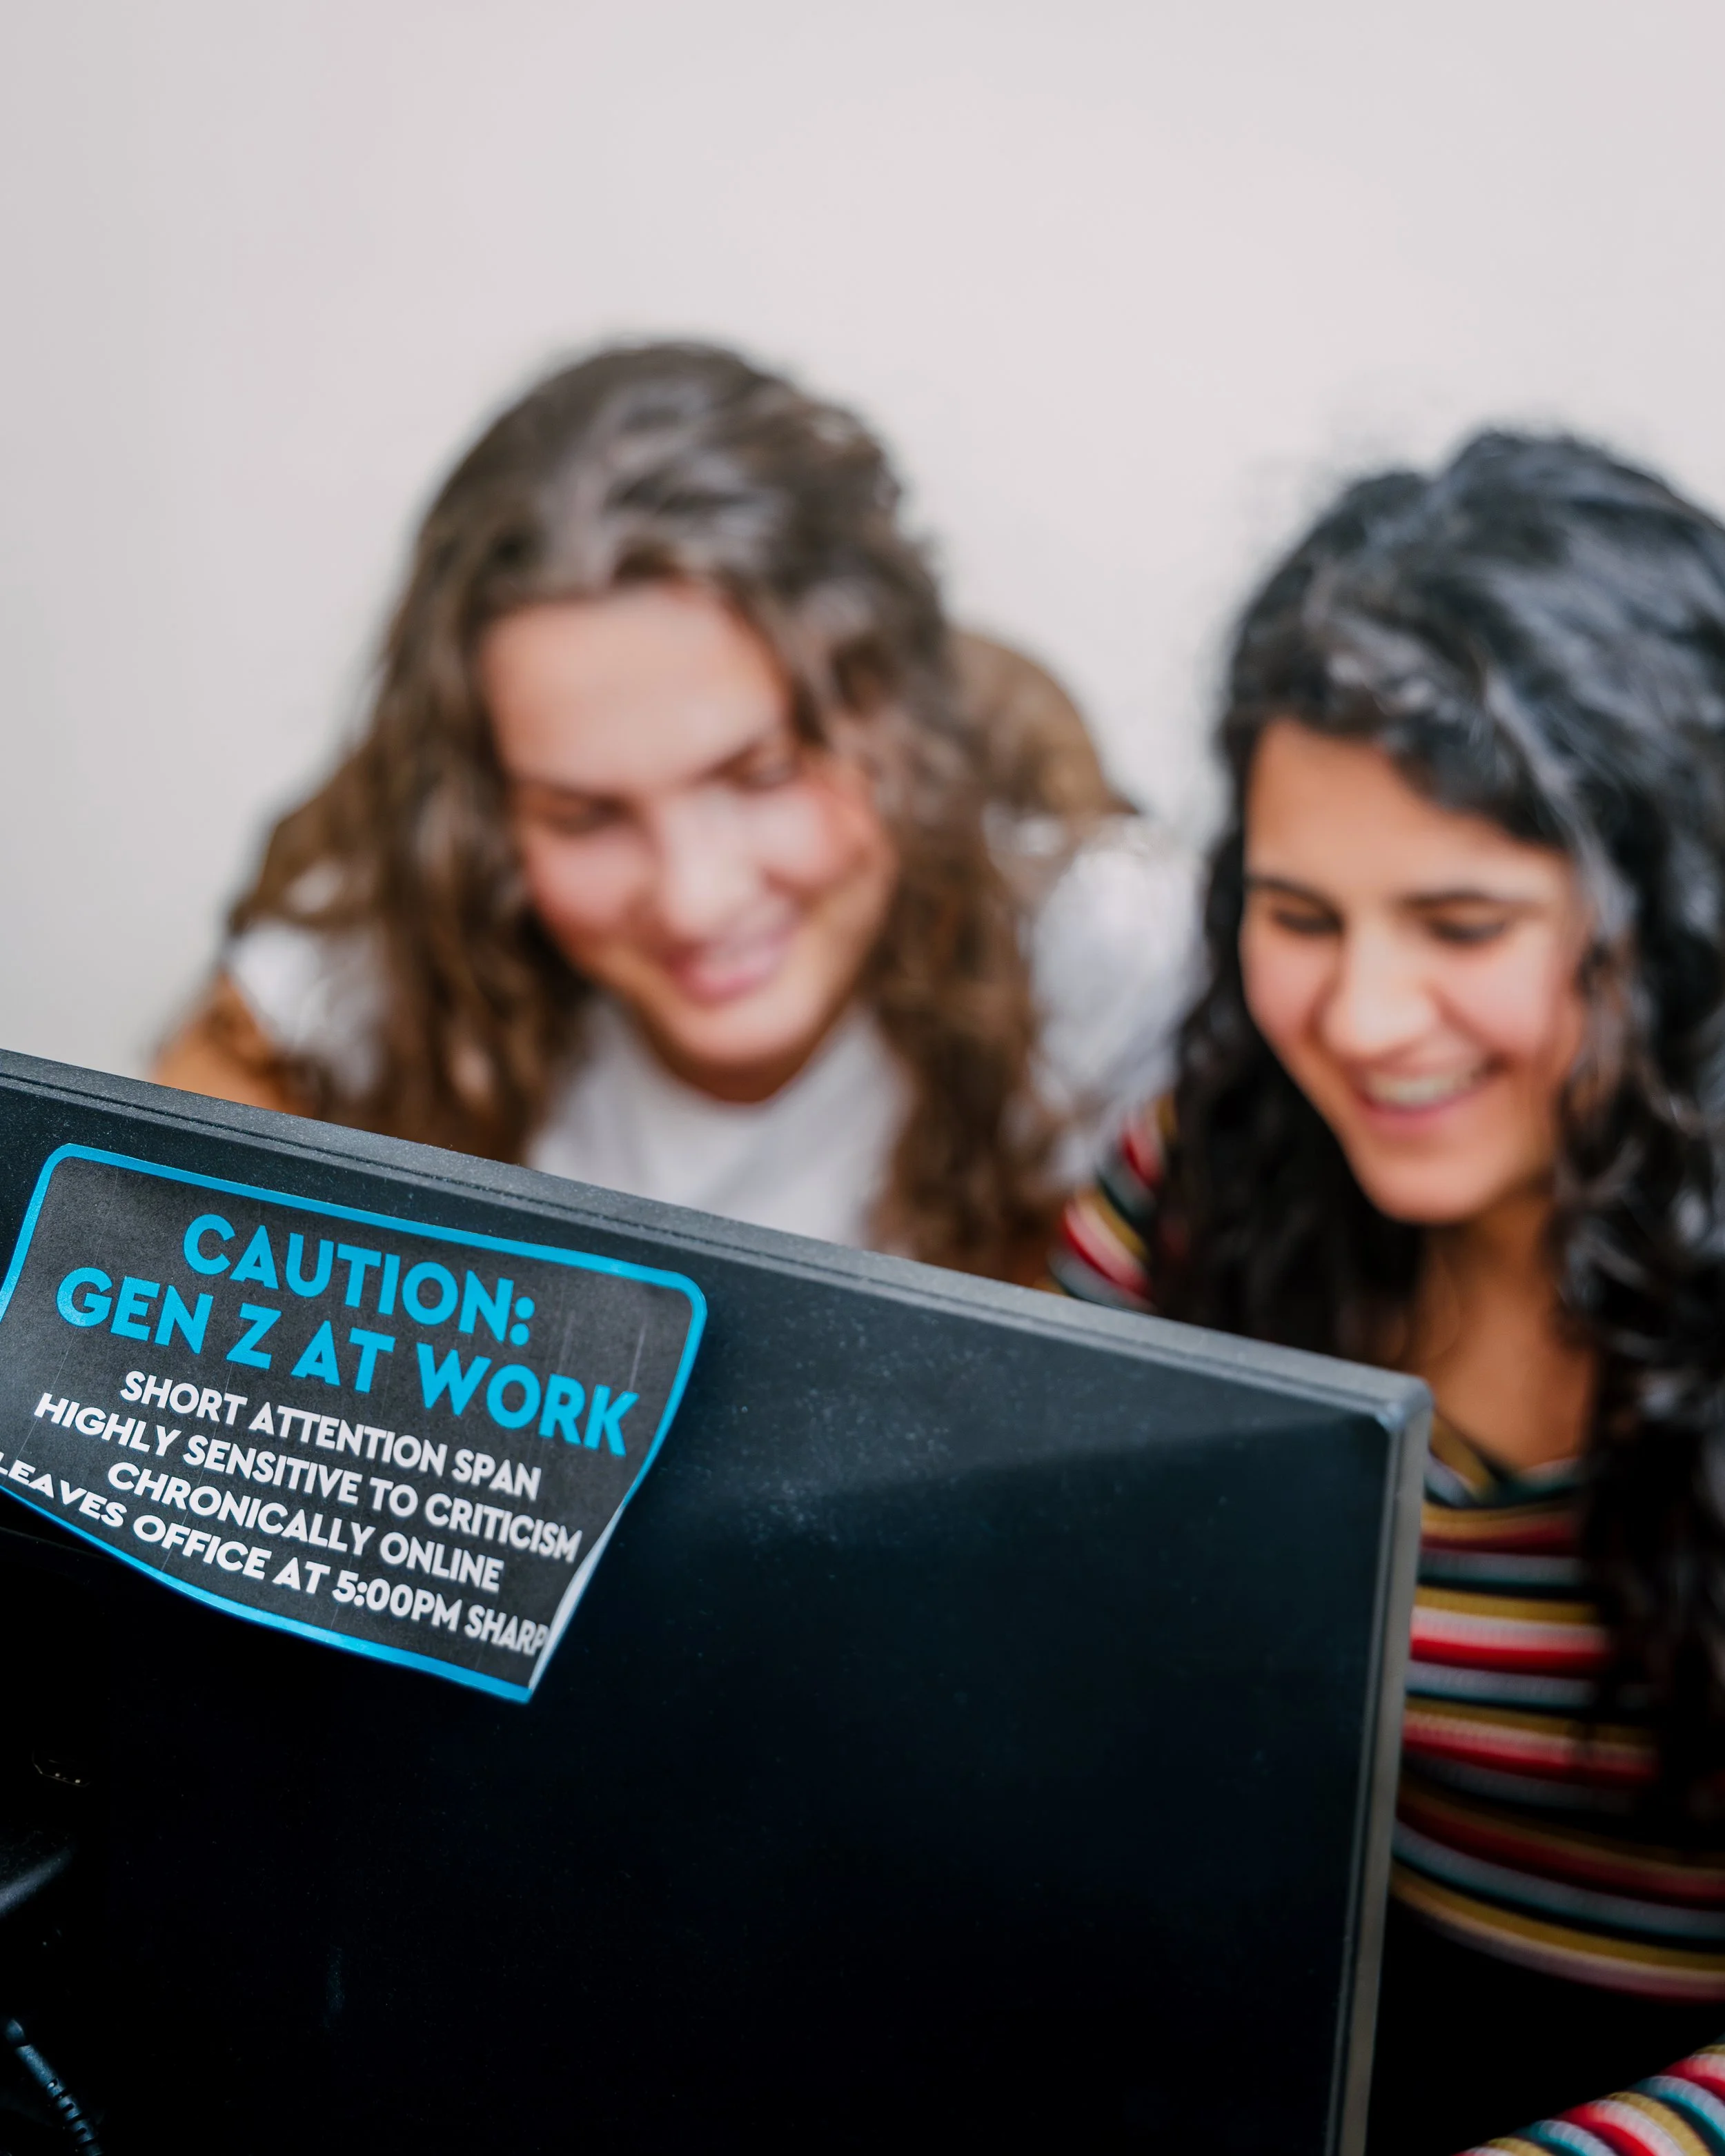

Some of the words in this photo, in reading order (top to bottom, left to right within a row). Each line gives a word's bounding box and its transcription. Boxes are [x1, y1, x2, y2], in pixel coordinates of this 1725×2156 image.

[183, 1214, 535, 1347] CAUTION:
[56, 1267, 213, 1354] GEN
[226, 1303, 282, 1369] Z
[290, 1320, 395, 1394] AT
[416, 1342, 640, 1456] WORK
[120, 1370, 248, 1425] SHORT
[248, 1401, 448, 1476] ATTENTION
[451, 1449, 542, 1501] SPAN
[34, 1392, 181, 1456] HIGHLY
[183, 1434, 363, 1505] SENSITIVE
[369, 1477, 418, 1517] TO
[424, 1493, 582, 1563] CRITICISM
[108, 1462, 376, 1556] CHRONICALLY
[379, 1532, 504, 1593] ONLINE
[0, 1452, 128, 1527] LEAVES
[133, 1514, 272, 1579] OFFICE
[273, 1557, 331, 1594] AT
[332, 1569, 462, 1632] 5:00PM
[464, 1604, 550, 1656] SHARP
